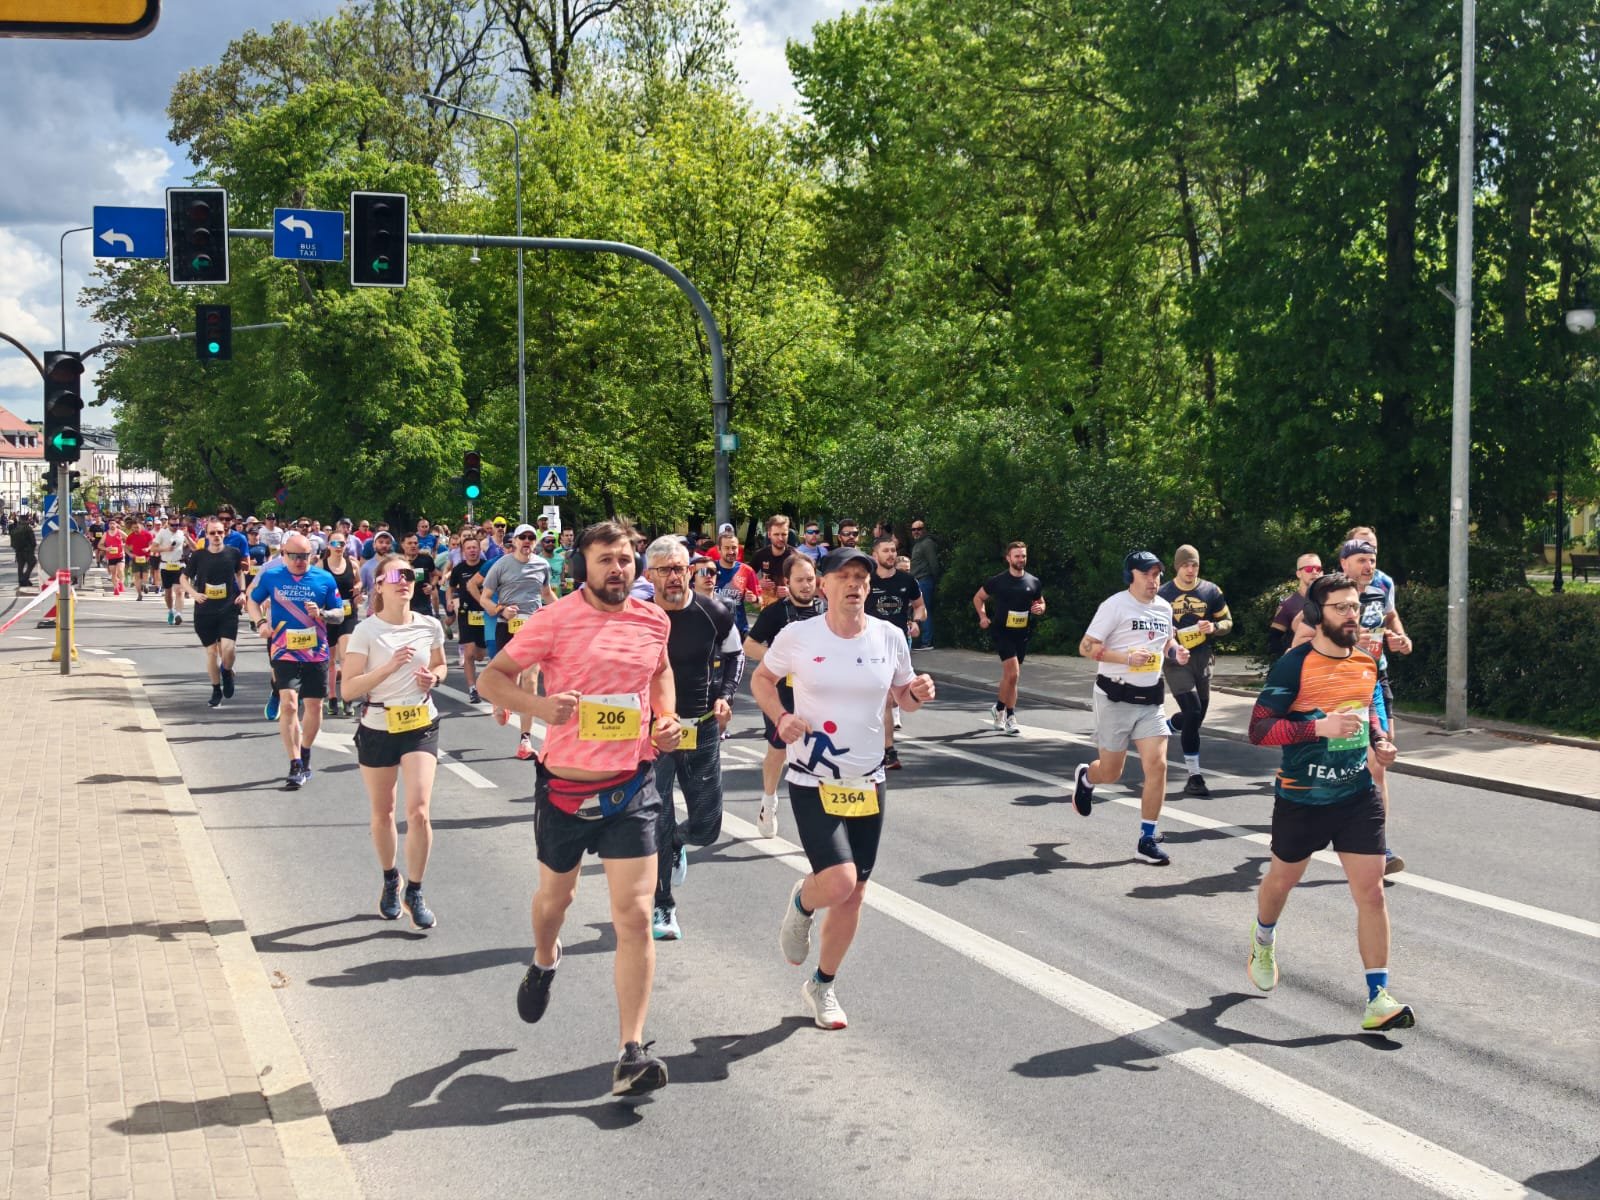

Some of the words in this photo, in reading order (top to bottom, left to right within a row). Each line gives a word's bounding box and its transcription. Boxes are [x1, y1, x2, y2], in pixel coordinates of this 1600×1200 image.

[395, 707, 421, 721] 1941
[596, 710, 626, 725] 206
[830, 791, 866, 804] 2364
